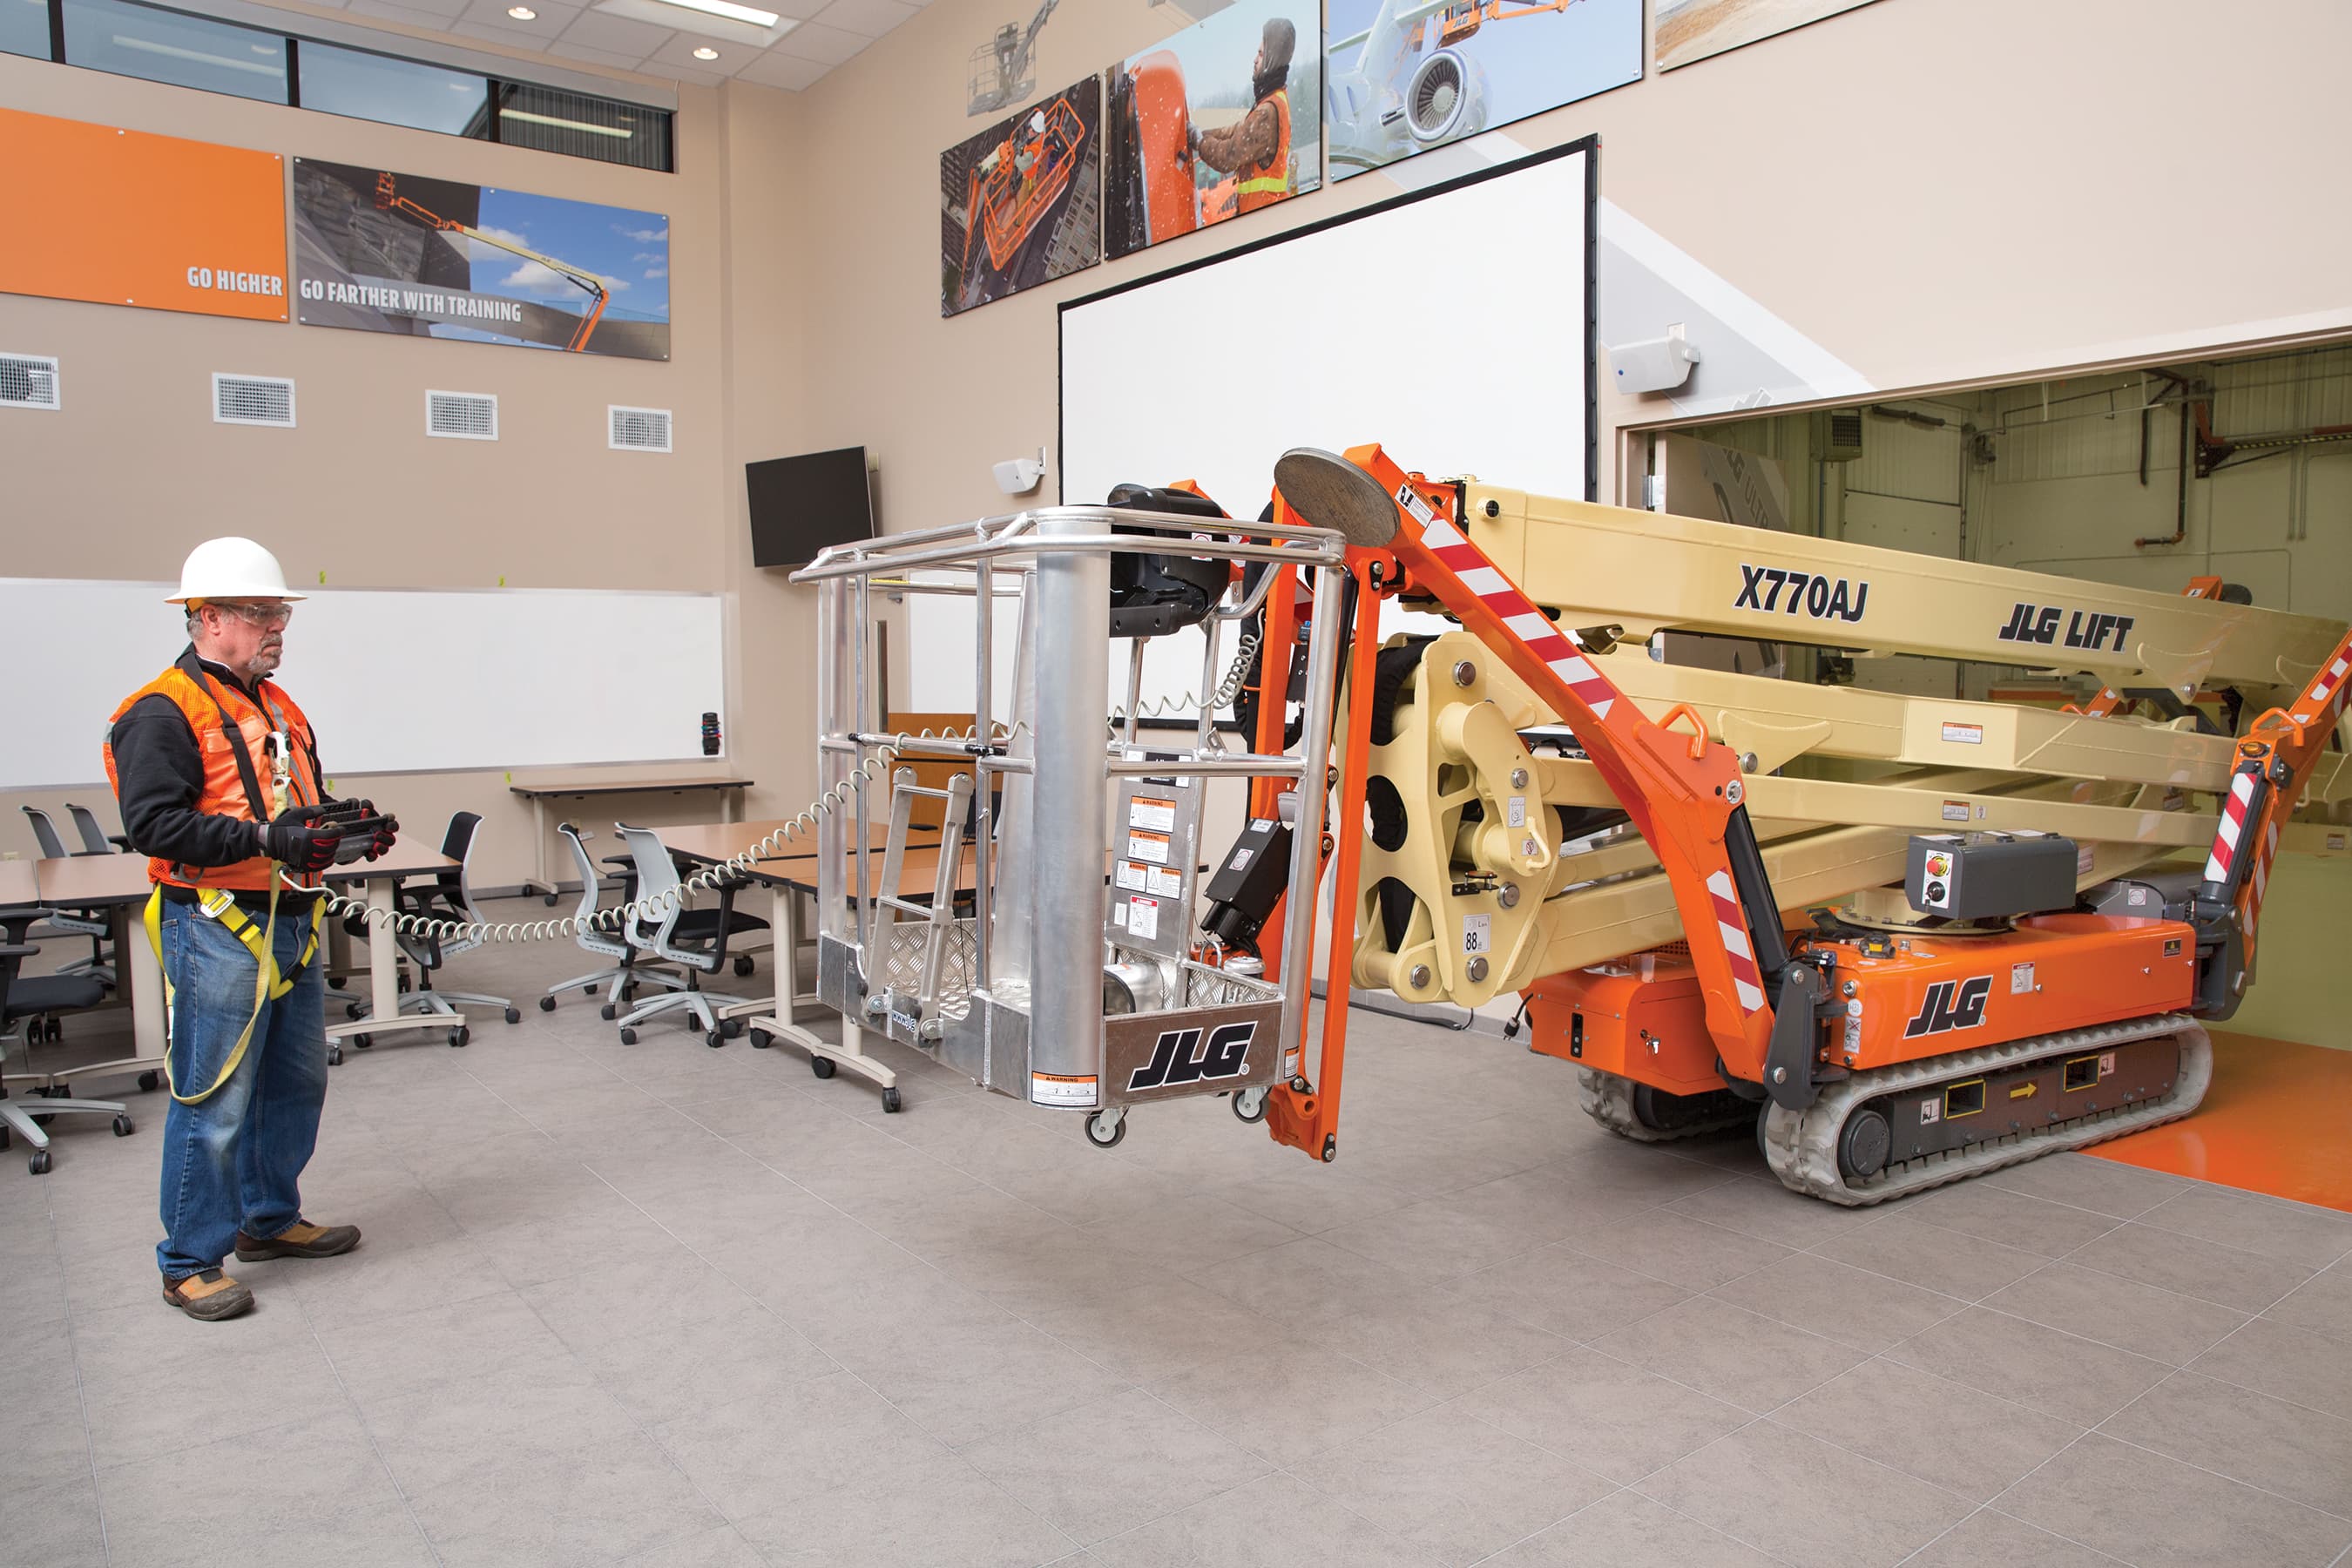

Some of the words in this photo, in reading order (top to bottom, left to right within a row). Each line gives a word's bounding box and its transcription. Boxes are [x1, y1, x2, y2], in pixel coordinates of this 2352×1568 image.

[1453, 16, 1469, 28] JLG
[187, 267, 212, 288] GO
[217, 269, 283, 296] HIGHER
[301, 279, 324, 300] GO
[328, 281, 400, 309] FARTHER
[403, 290, 444, 314] WITH
[448, 296, 522, 322] TRAINING
[1734, 564, 1869, 624] X770AJ
[1998, 603, 2063, 645] JLG
[2062, 611, 2135, 653] LIFT
[1466, 932, 1477, 950] 88
[1903, 975, 1993, 1039] JLG
[1126, 1021, 1258, 1092] JLG
